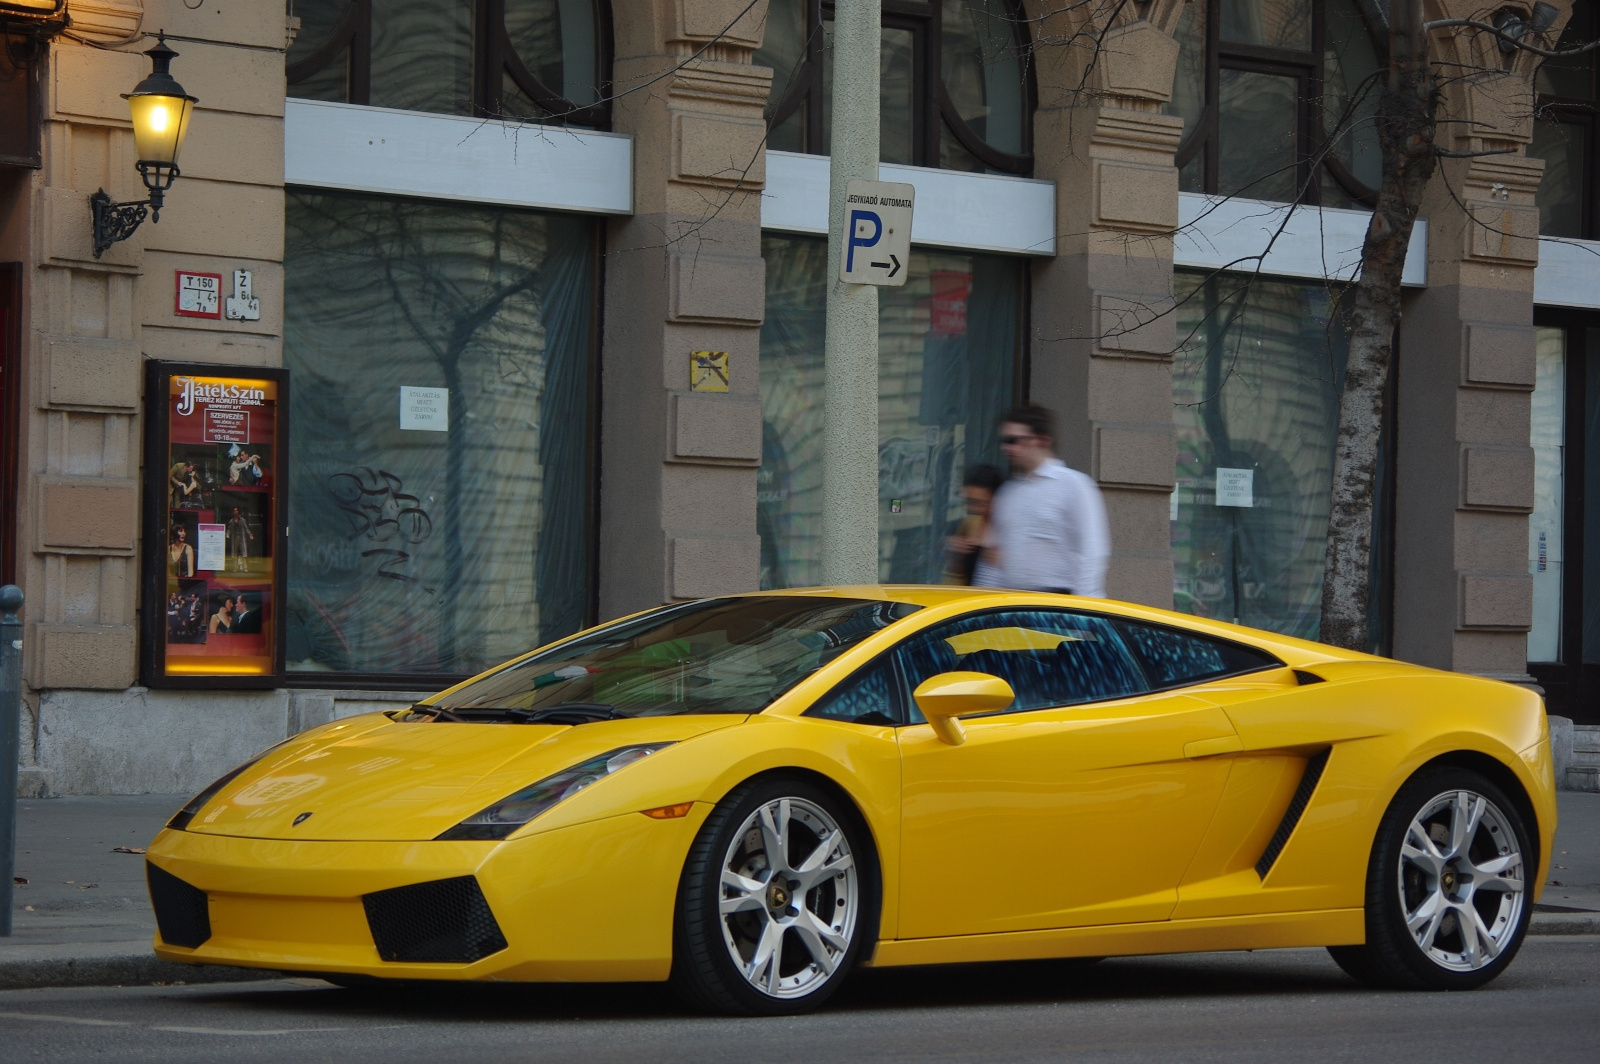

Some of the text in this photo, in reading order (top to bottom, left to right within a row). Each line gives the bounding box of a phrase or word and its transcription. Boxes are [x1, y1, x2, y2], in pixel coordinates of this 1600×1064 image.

[847, 194, 912, 208] JEGYKIADÓ AUTOMATA
[846, 209, 882, 272] P
[187, 276, 213, 288] T 150
[239, 276, 247, 287] Z
